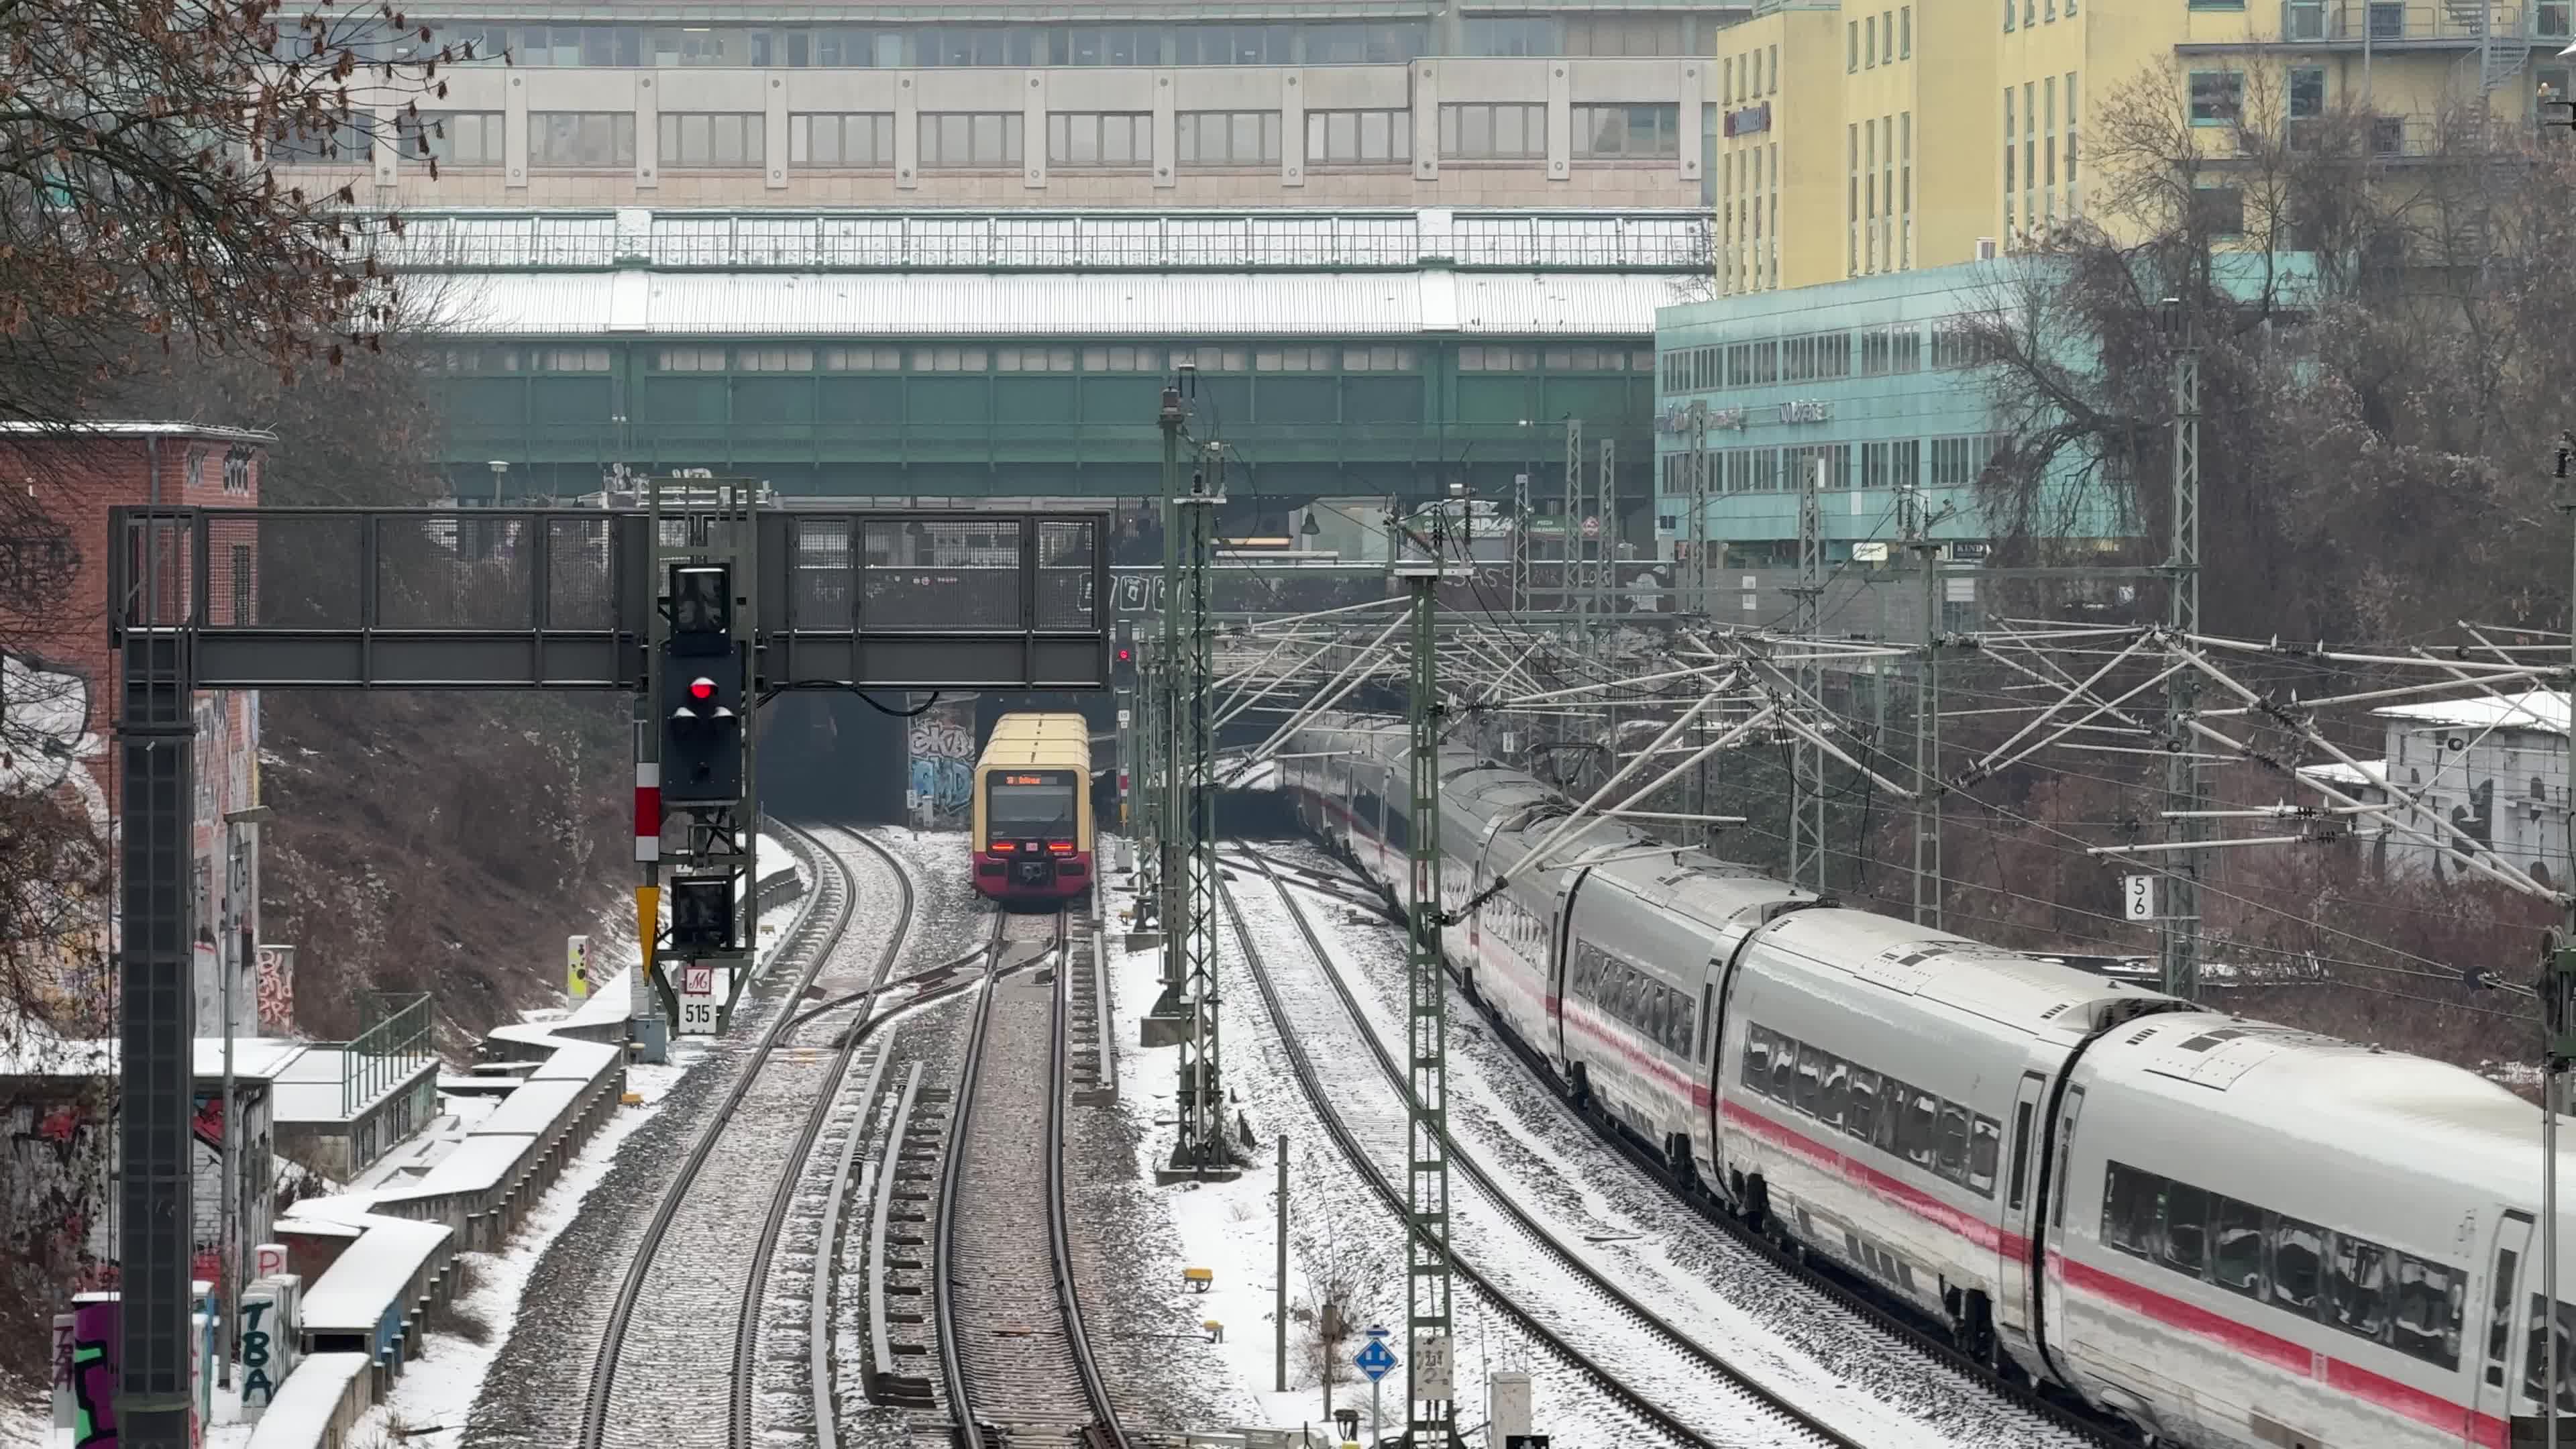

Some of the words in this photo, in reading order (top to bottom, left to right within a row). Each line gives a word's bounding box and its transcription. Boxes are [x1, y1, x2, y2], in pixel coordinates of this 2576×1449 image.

[2134, 877, 2145, 895] 5
[2134, 897, 2145, 915] 6
[685, 1004, 710, 1024] 515
[241, 1301, 274, 1406] TBA
